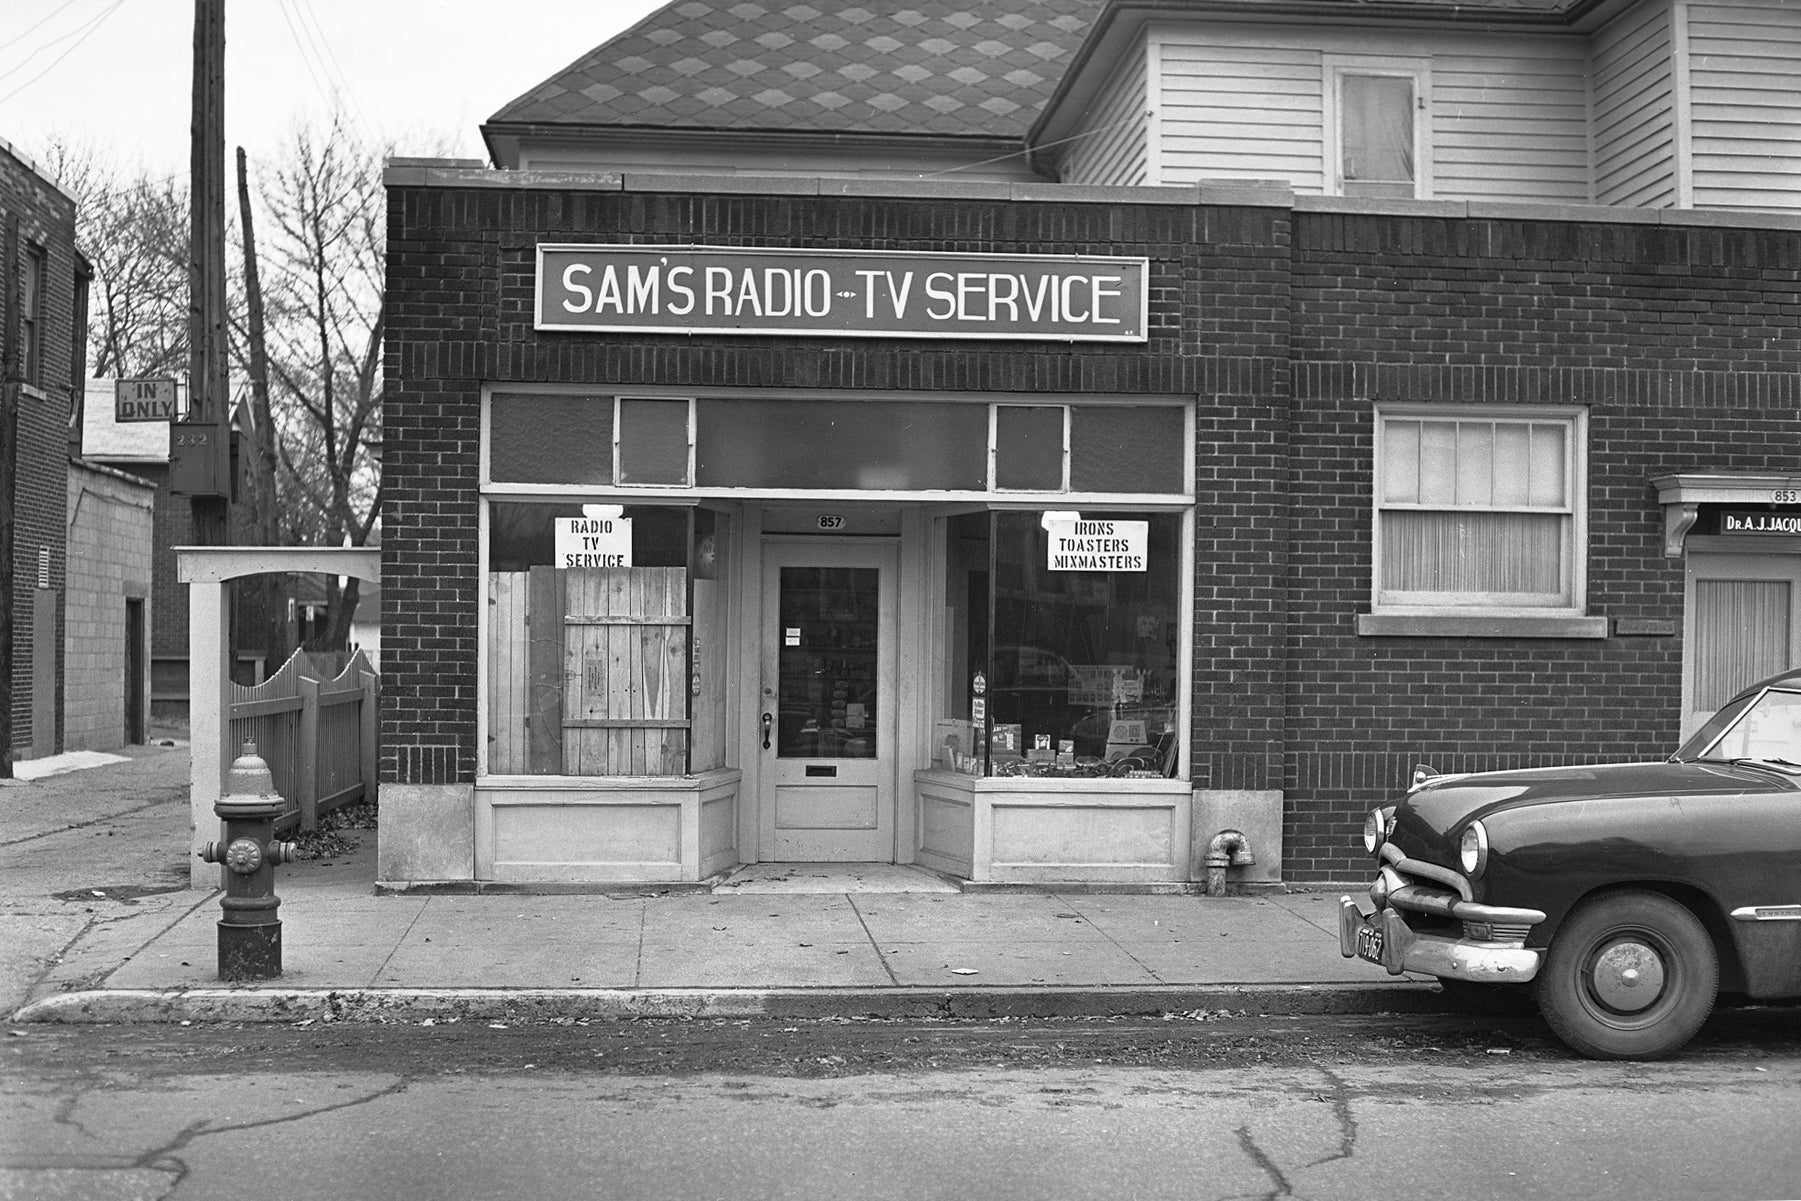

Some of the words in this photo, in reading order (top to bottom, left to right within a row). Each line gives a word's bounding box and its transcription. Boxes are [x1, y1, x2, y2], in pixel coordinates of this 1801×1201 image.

[562, 257, 695, 315] SAM'S
[705, 266, 831, 317] RADIO
[855, 270, 914, 319] TV
[925, 272, 1121, 323] SERVICE
[136, 383, 157, 399] IN
[121, 401, 173, 417] ONLY
[177, 434, 207, 446] 232
[1775, 490, 1797, 502] 853
[571, 520, 613, 533] RADIO
[820, 516, 842, 527] 857
[1075, 522, 1114, 535] IRONS
[583, 537, 599, 550] TV
[1059, 538, 1129, 552] TOASTERS
[566, 554, 624, 567] SERVICE
[1054, 555, 1142, 569] MIXMASTERS
